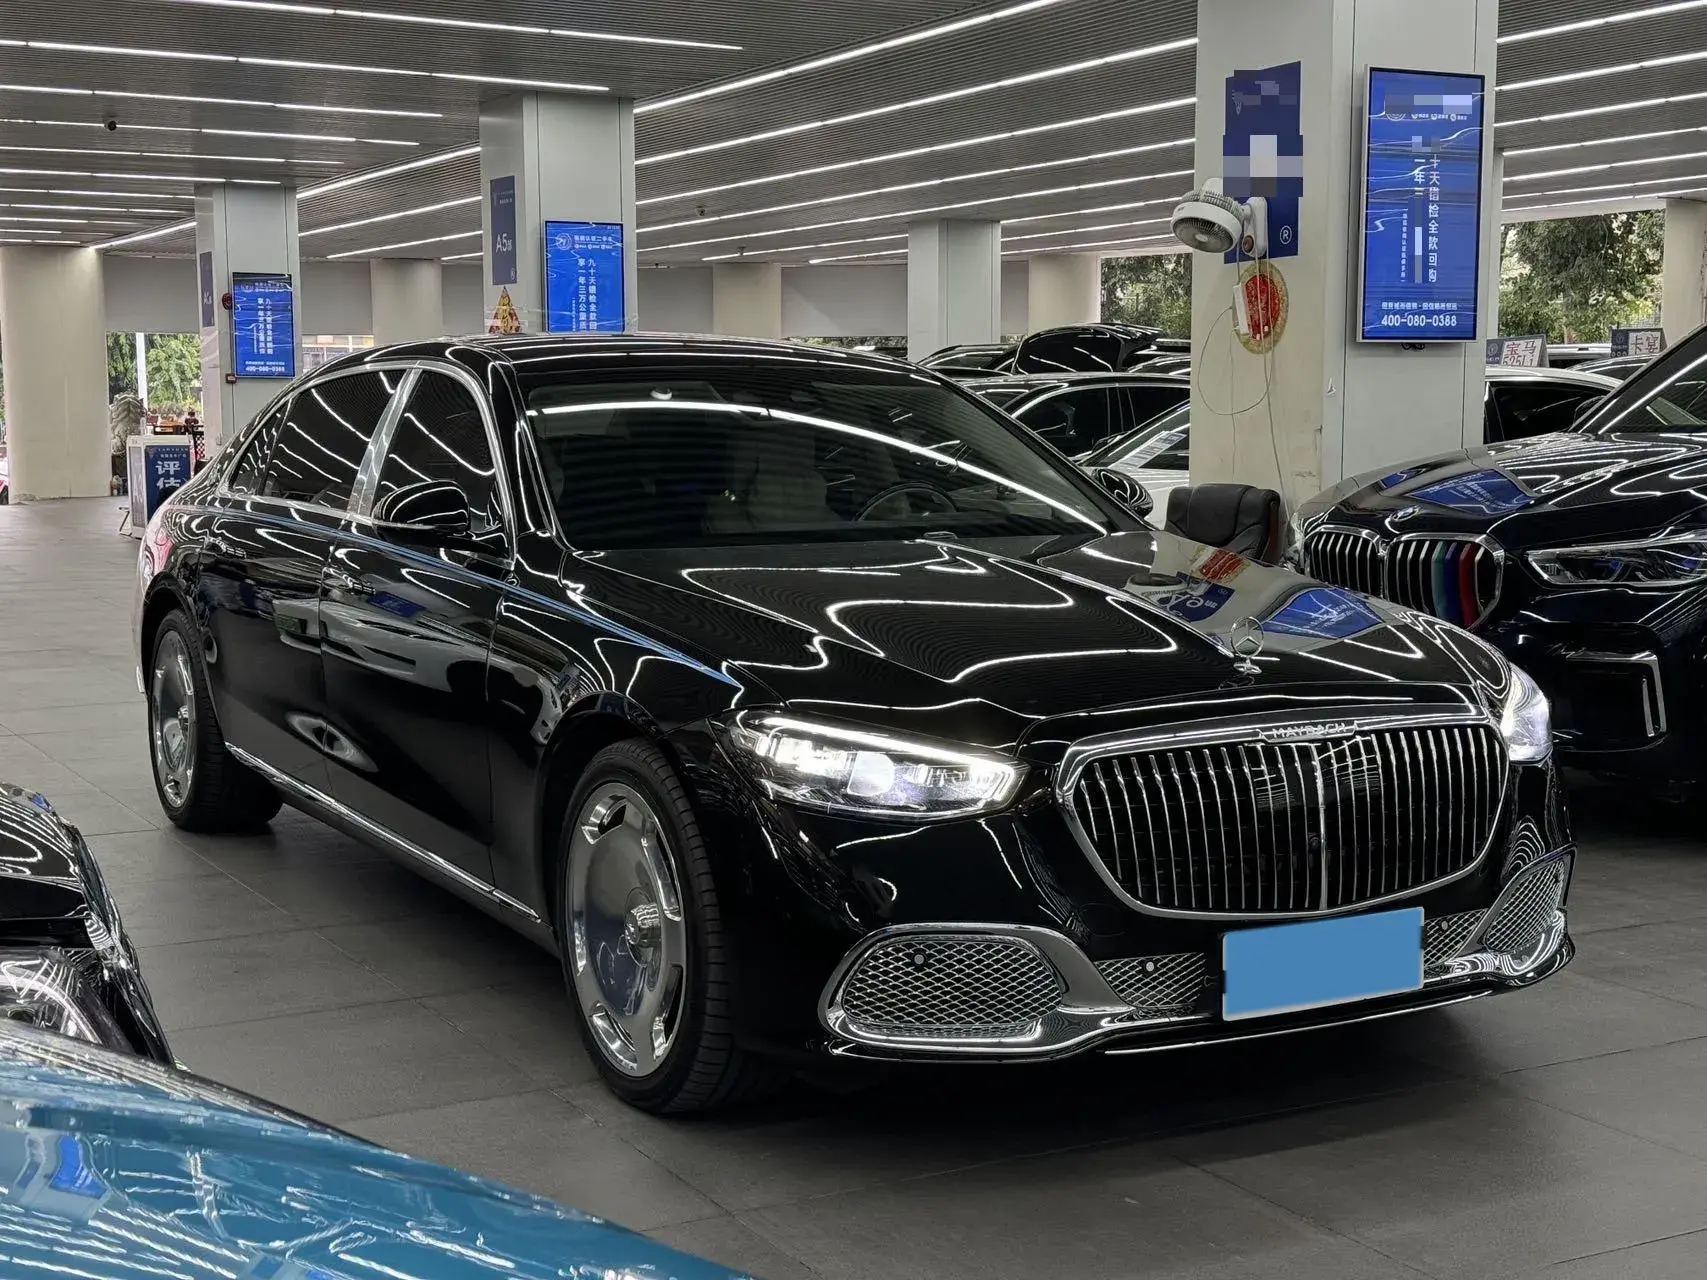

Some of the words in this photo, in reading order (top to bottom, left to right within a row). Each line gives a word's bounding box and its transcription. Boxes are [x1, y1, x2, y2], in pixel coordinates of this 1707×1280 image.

[1381, 315, 1457, 327] 400-080-0388
[1504, 341, 1537, 356] 宝马
[1272, 722, 1346, 739] MAYBACH
